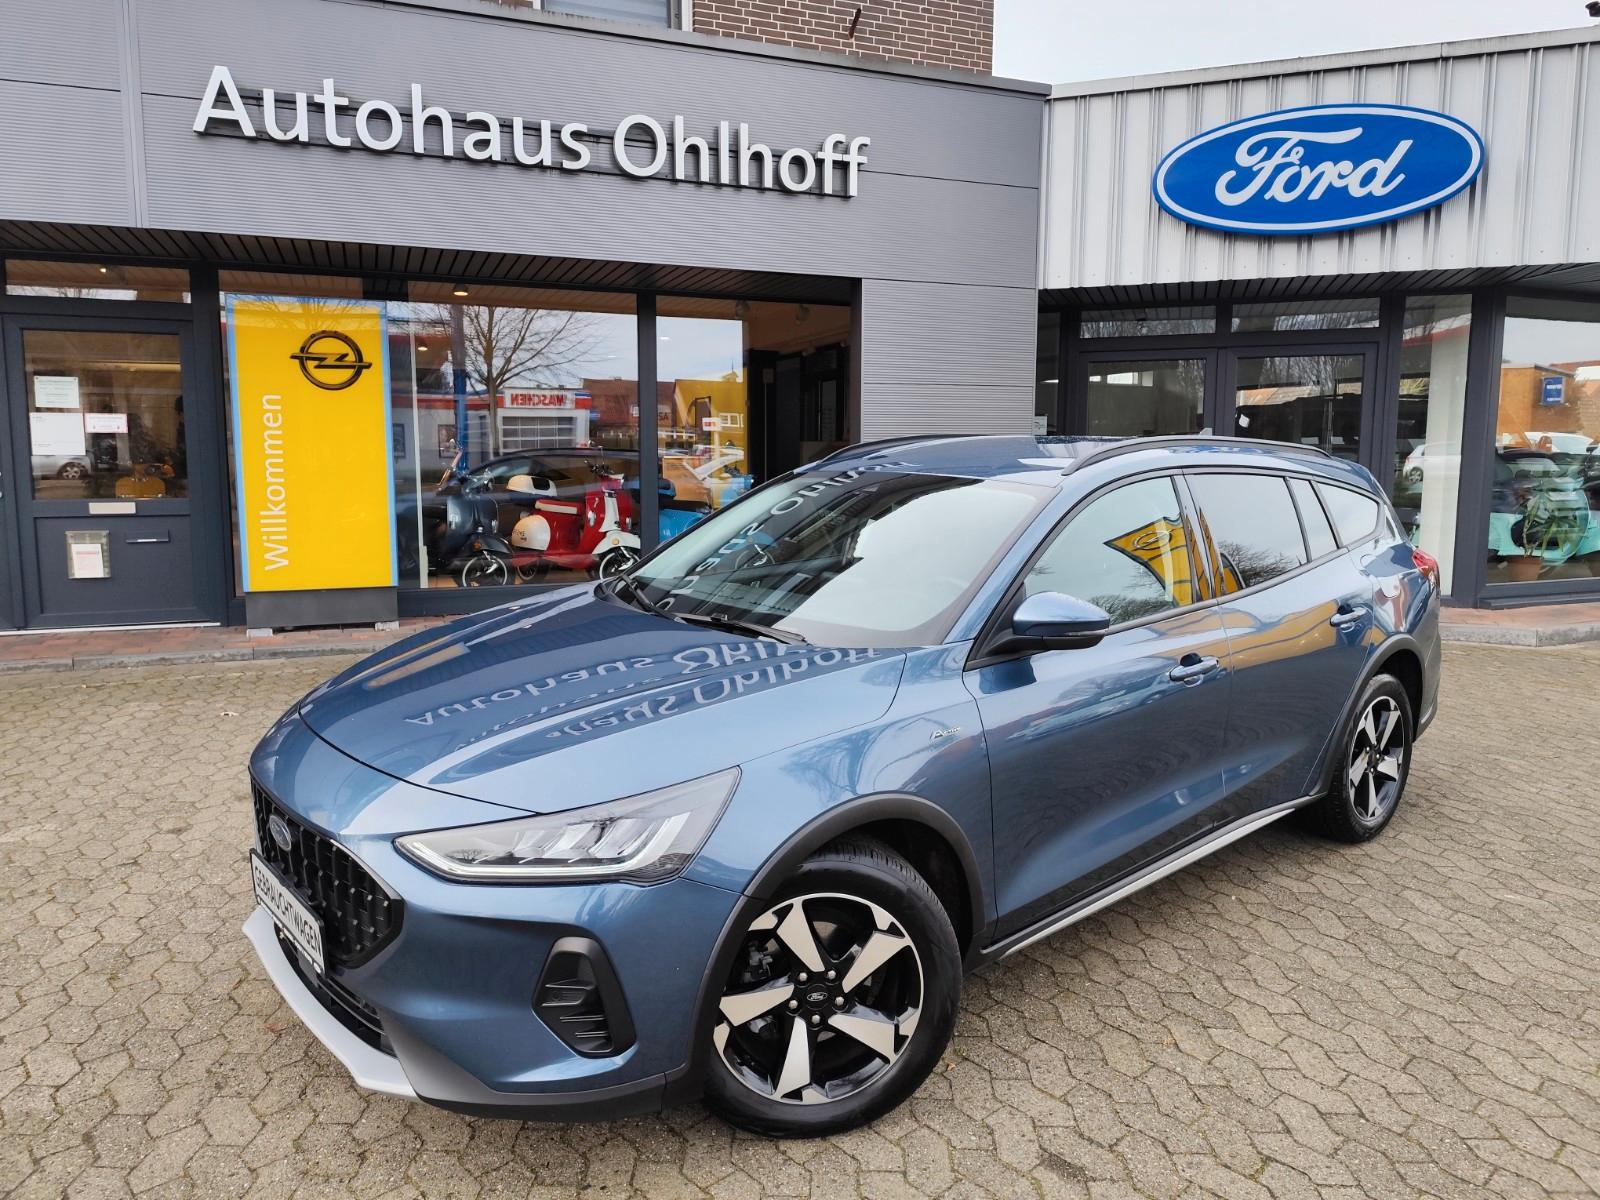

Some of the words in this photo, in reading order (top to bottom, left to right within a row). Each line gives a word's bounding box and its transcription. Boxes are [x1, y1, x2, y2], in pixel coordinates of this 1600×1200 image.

[193, 65, 591, 171] Autohaus
[613, 114, 870, 197] Ohlhoff
[1214, 127, 1413, 206] Ford
[259, 394, 289, 571] Willkommen
[254, 865, 323, 958] GEBRAUCHTWAGEN
